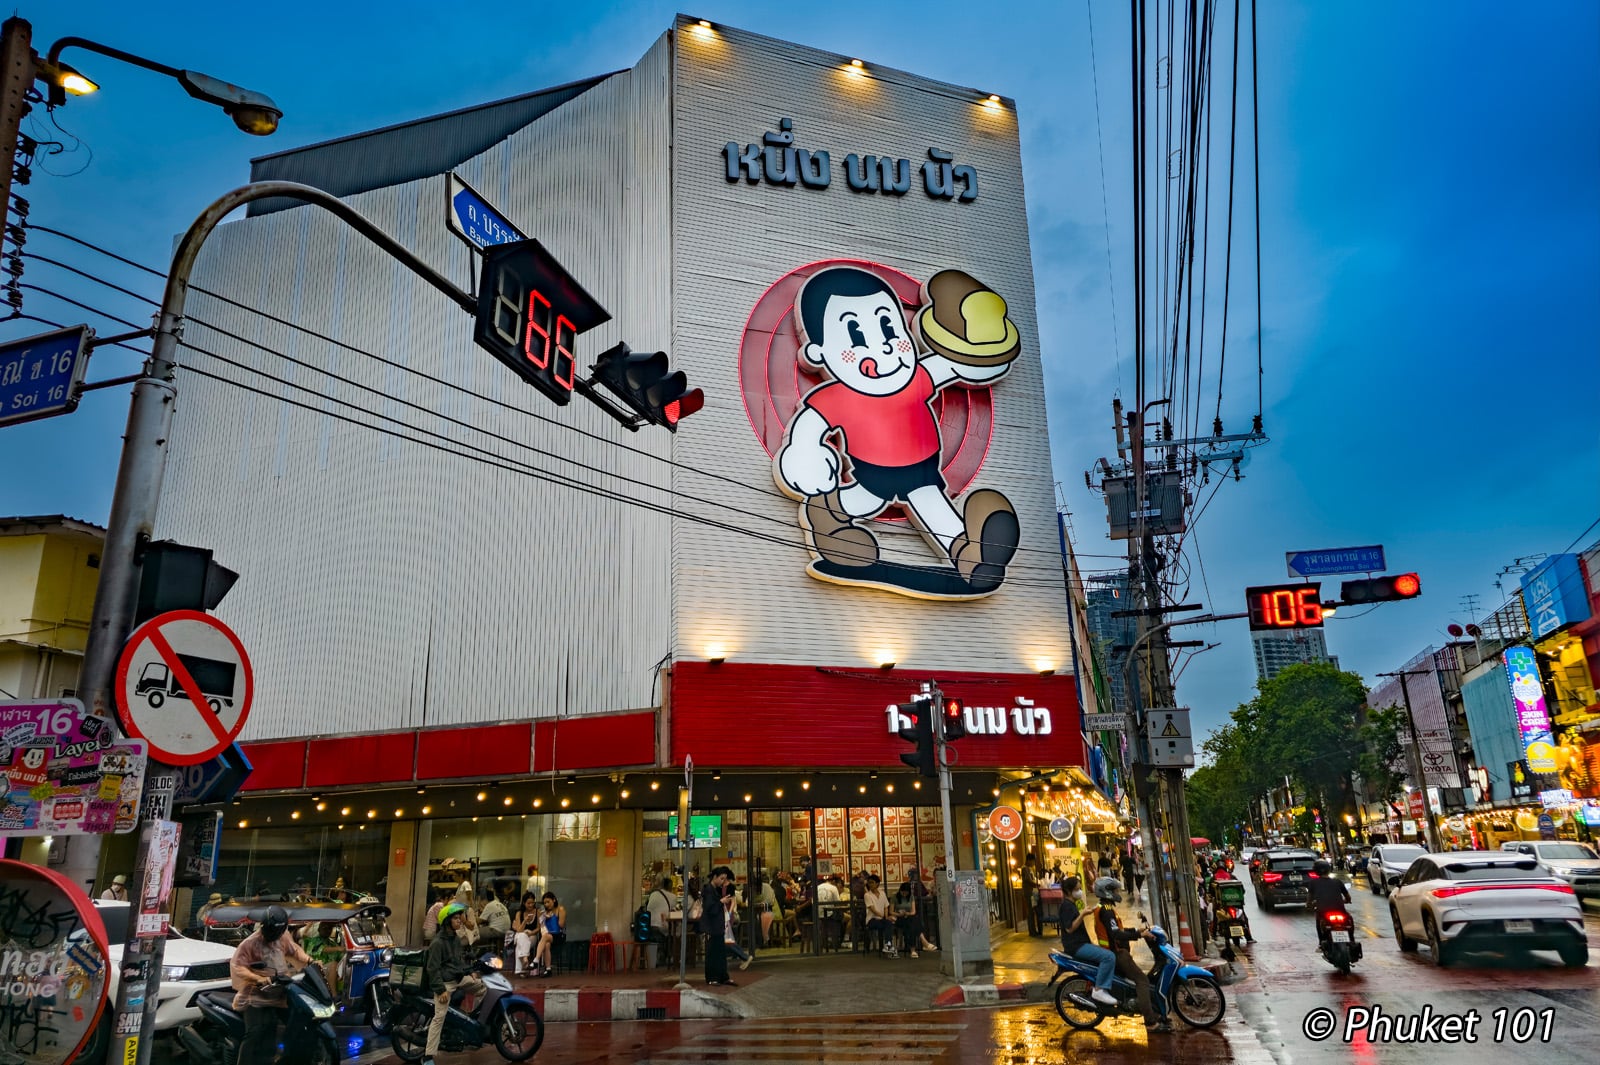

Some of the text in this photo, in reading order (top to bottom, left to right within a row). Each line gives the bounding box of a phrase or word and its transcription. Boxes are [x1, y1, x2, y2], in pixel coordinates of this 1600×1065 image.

[722, 117, 979, 202] หนึ่ง นม นัว
[468, 205, 480, 226] ถ.
[50, 349, 73, 376] 16
[12, 390, 39, 409] Soi
[48, 384, 65, 402] 16
[1369, 551, 1379, 560] 16
[1261, 588, 1323, 626] 106
[0, 710, 31, 721] ฬาฯ
[36, 708, 73, 735] 16
[963, 706, 1007, 735] นม
[1010, 696, 1052, 735] นัว
[1521, 710, 1544, 719] SKIN
[1521, 717, 1548, 726] CARE
[1423, 765, 1453, 773] OYOTA
[948, 869, 953, 879] 8
